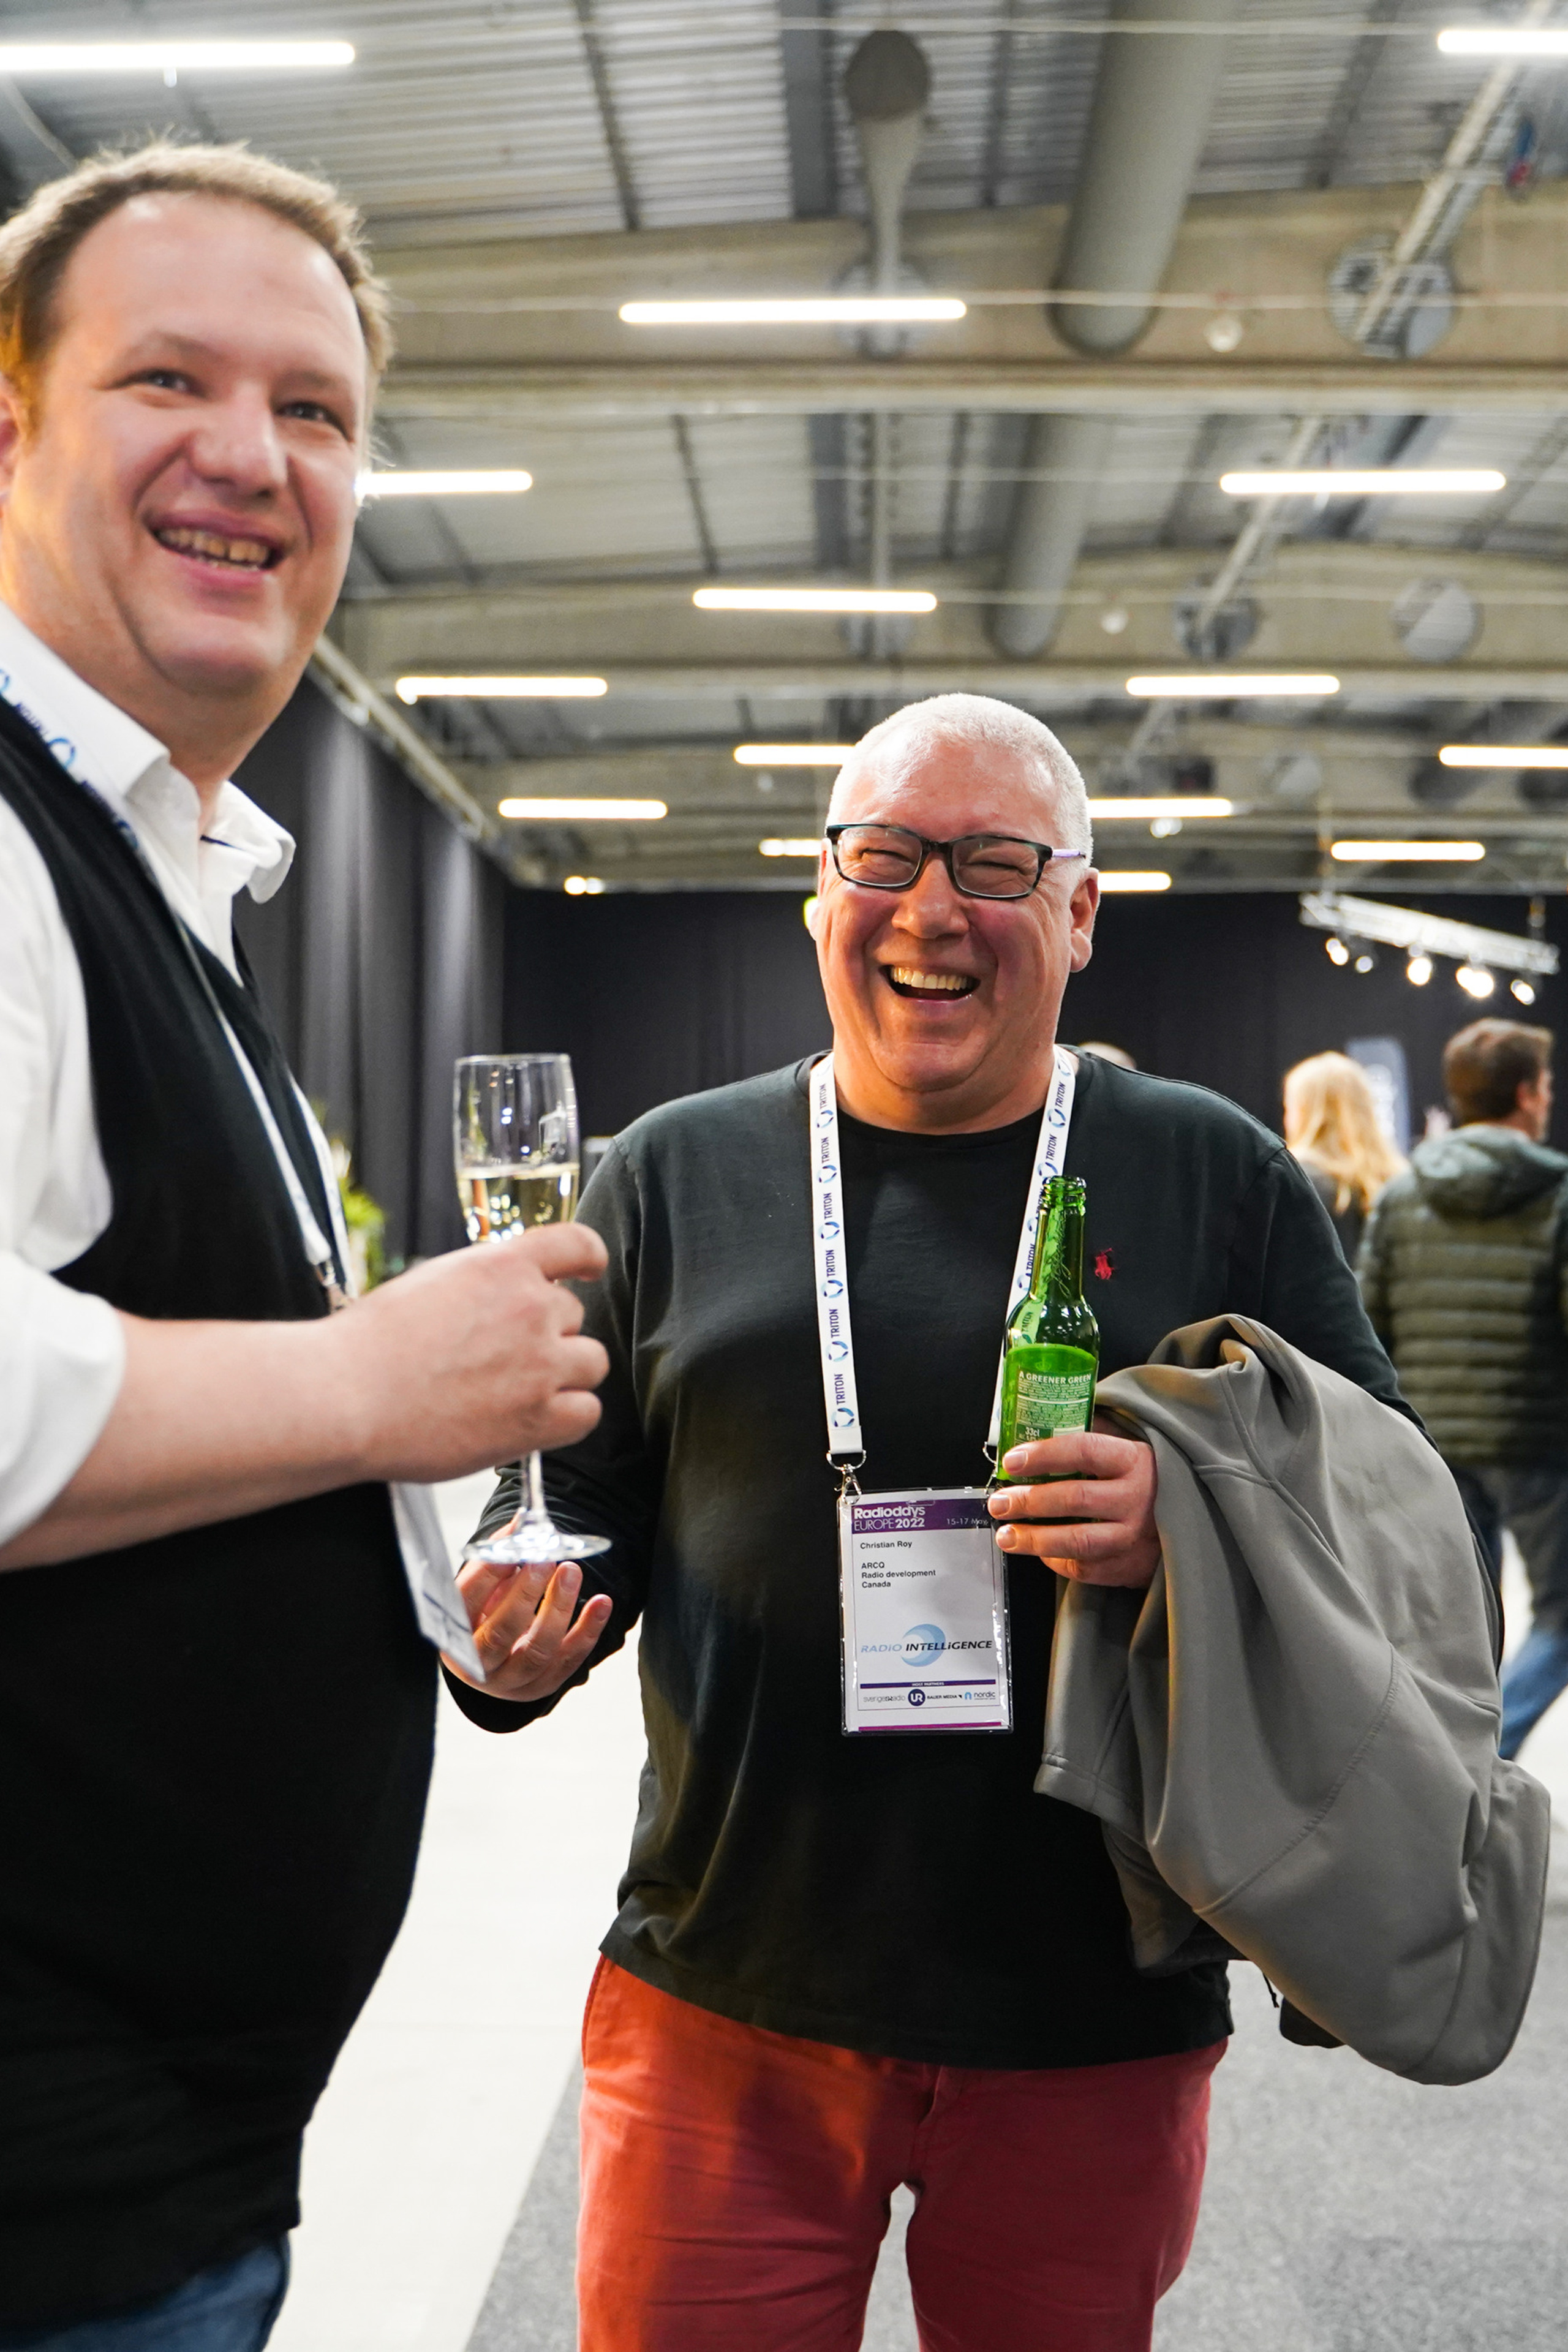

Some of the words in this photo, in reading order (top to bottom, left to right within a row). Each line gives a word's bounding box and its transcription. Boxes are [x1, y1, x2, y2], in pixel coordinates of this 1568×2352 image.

[1055, 1082, 1066, 1107] TRITON
[1046, 1134, 1057, 1161] TRITON
[824, 1192, 832, 1219] TRITON
[826, 1249, 836, 1278] TRITON
[829, 1309, 840, 1338] TRITON
[1026, 1373, 1066, 1384] GREENER
[1068, 1373, 1091, 1384] GREEN
[834, 1373, 846, 1405] TRITON
[1025, 1427, 1040, 1437] 33cl
[854, 1506, 925, 1520] Radiodays
[854, 1518, 895, 1531] EUROPE
[895, 1518, 925, 1529] 2022
[886, 1570, 936, 1578] development
[910, 1693, 923, 1703] UR
